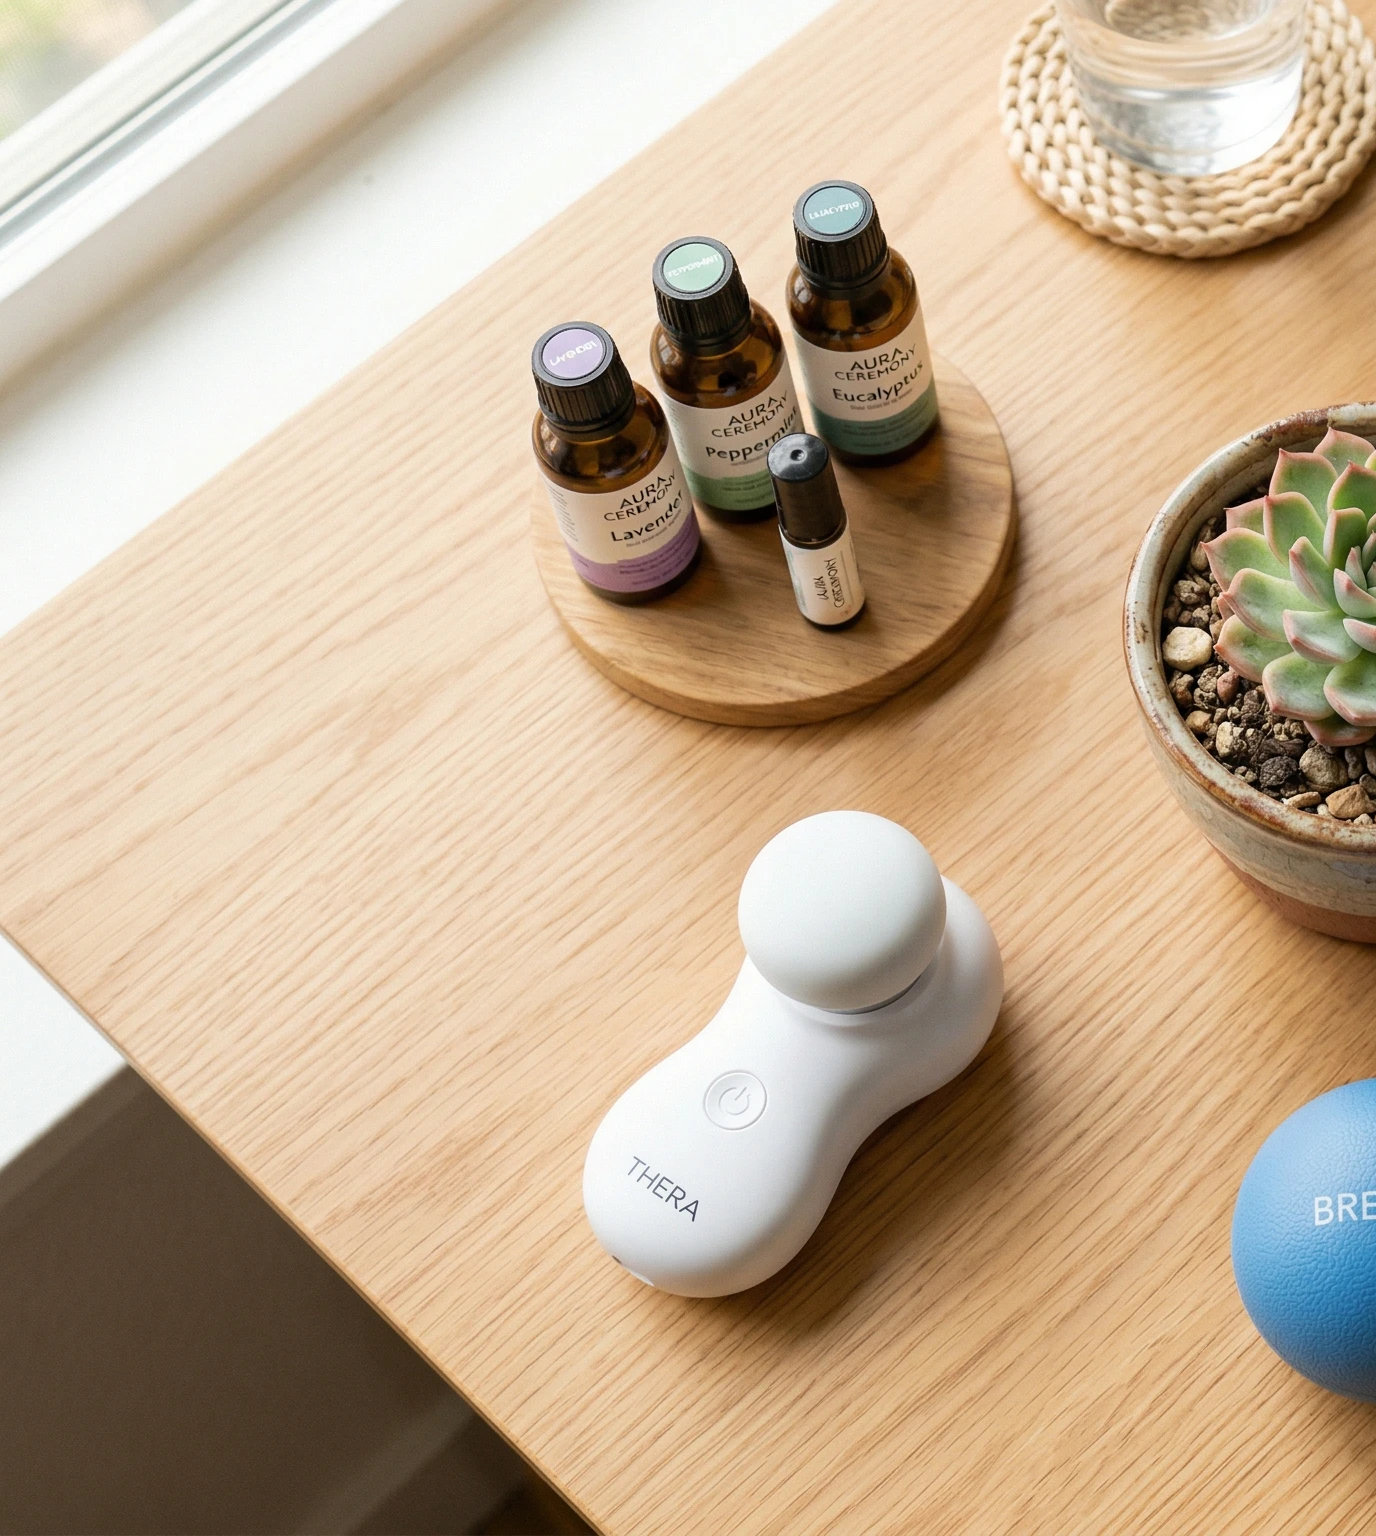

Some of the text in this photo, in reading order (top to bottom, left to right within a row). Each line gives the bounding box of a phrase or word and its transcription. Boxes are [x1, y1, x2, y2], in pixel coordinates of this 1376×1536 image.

[834, 343, 917, 381] CEREMONY
[850, 347, 903, 371] AURA
[832, 360, 923, 403] Eucalyptus
[728, 396, 778, 426] AURA
[620, 476, 666, 509] AURA
[627, 1156, 699, 1222] THERA
